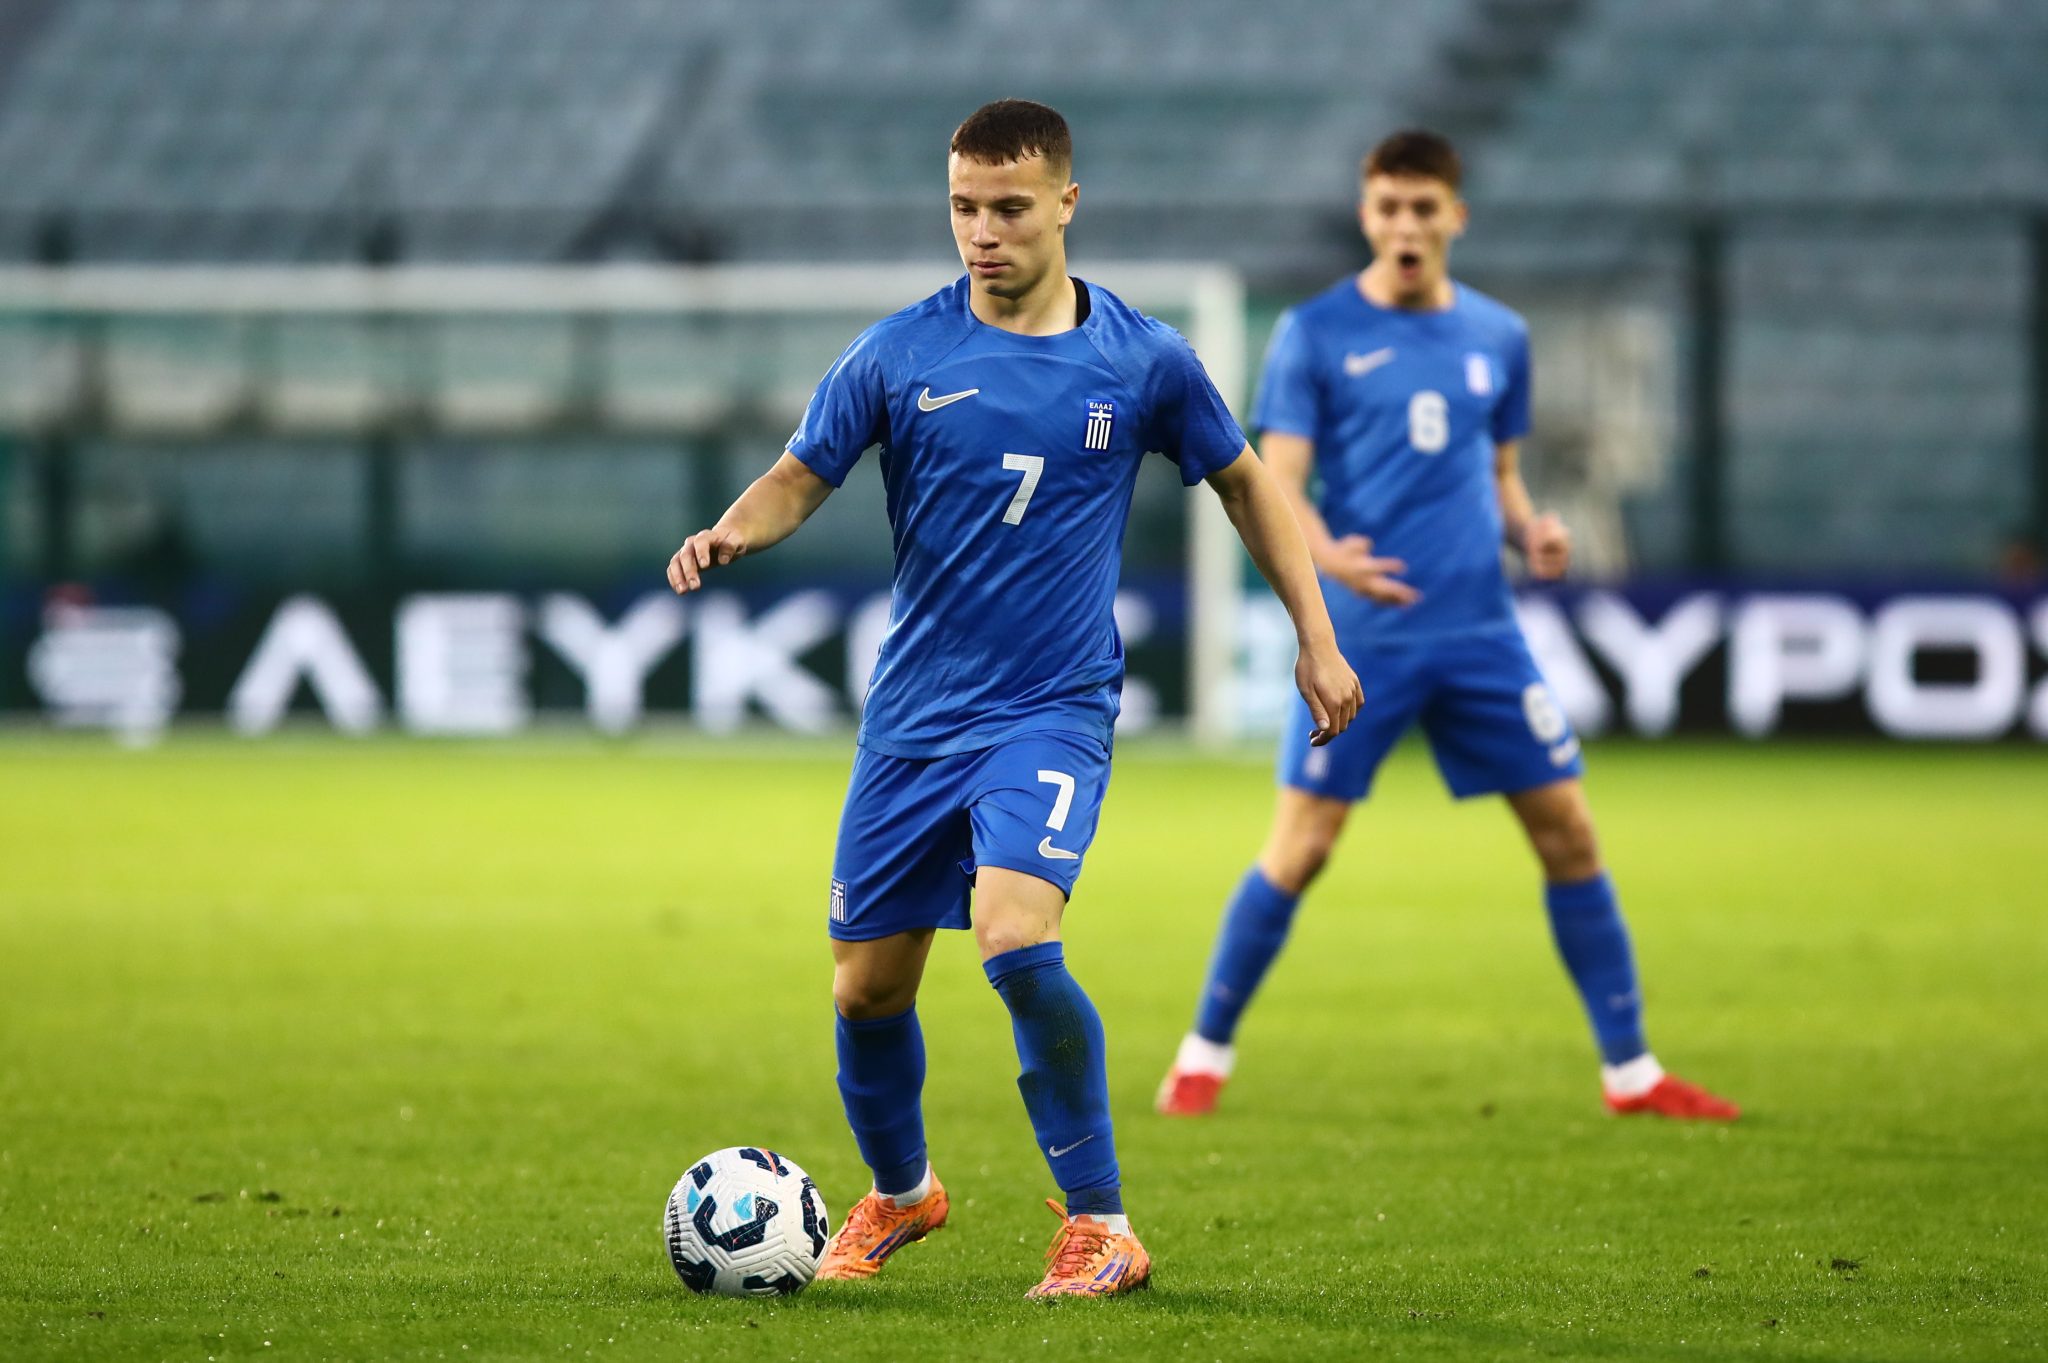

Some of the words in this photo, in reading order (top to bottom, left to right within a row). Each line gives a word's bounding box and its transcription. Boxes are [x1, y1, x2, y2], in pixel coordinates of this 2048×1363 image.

[1089, 402, 1113, 411] ΕΛΛΑΣ
[1409, 391, 1450, 453] 6
[1002, 452, 1045, 526] 7
[228, 592, 1155, 736] ΛΕΥΚ
[1037, 769, 1075, 832] 7
